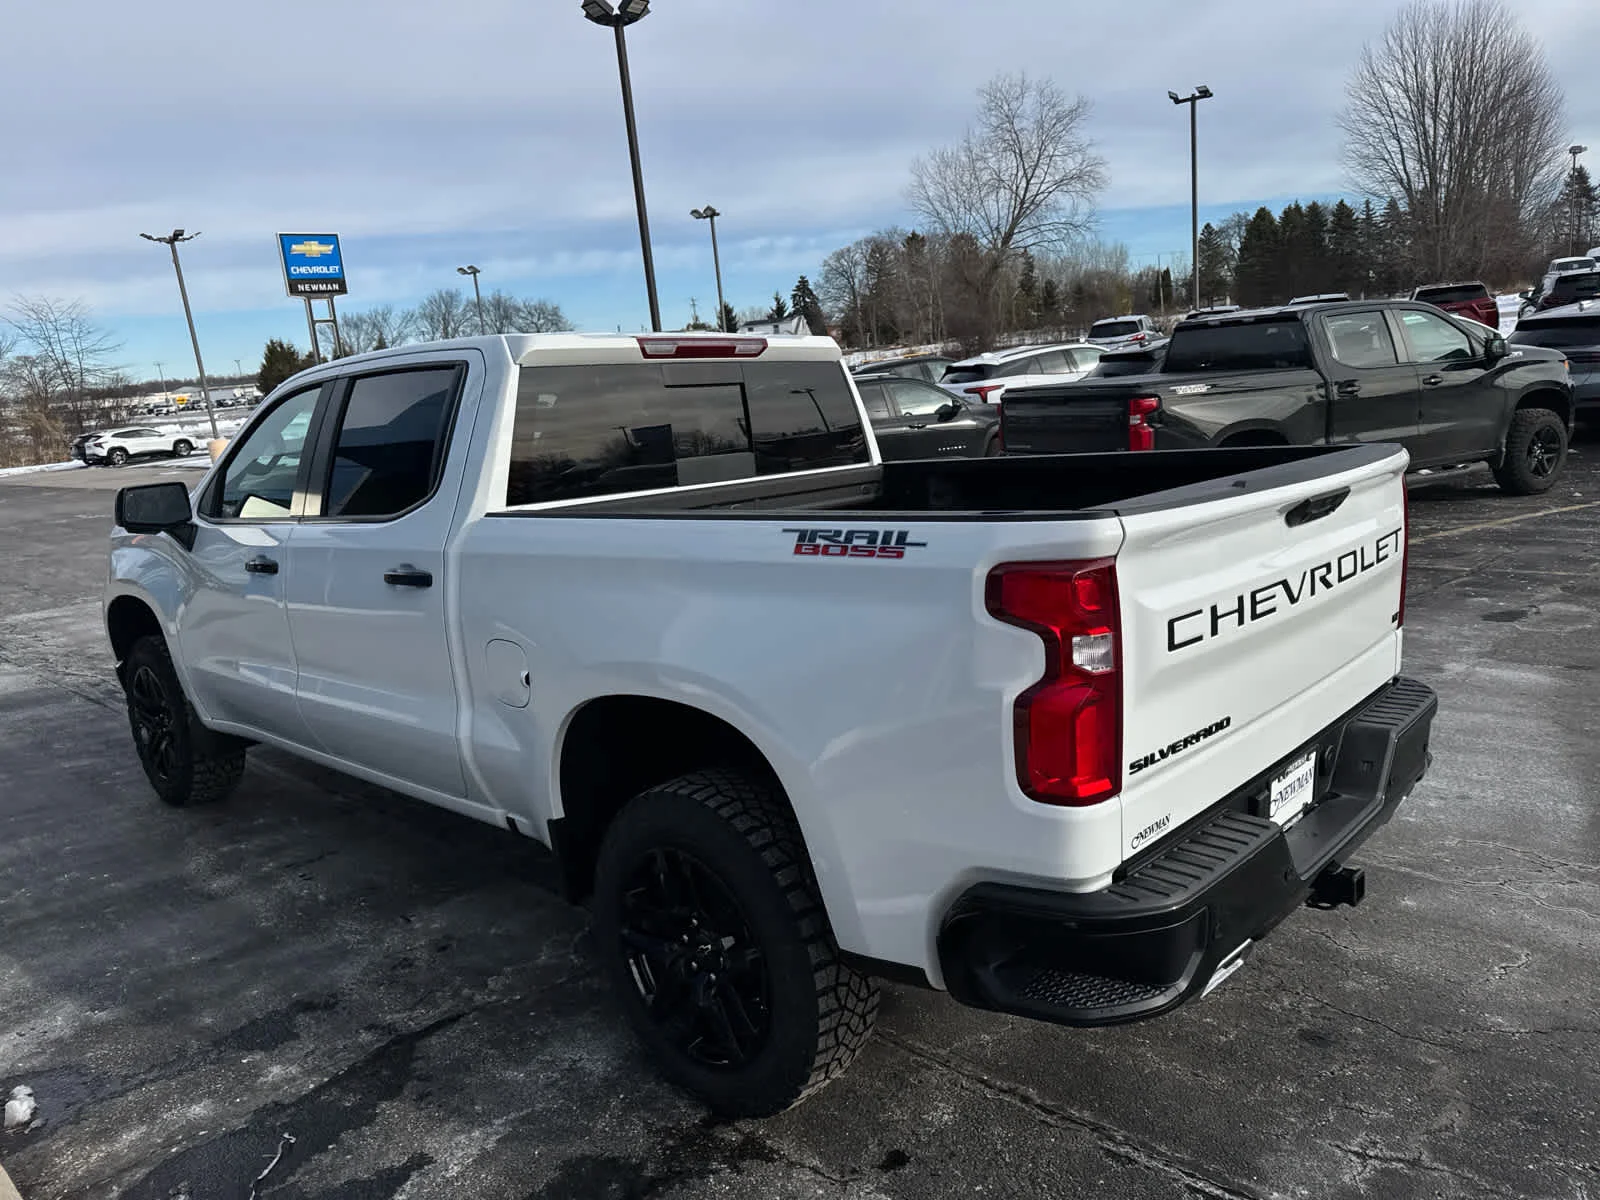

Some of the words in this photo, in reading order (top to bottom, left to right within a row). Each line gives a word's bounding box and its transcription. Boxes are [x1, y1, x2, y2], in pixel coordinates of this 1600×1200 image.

[290, 265, 339, 274] CHEVROLET
[297, 283, 339, 292] NEWMAN
[782, 528, 928, 547] TRAIL
[794, 543, 906, 559] BOSS
[1167, 527, 1402, 652] CHEVROLET
[1129, 715, 1232, 776] SILVERADO
